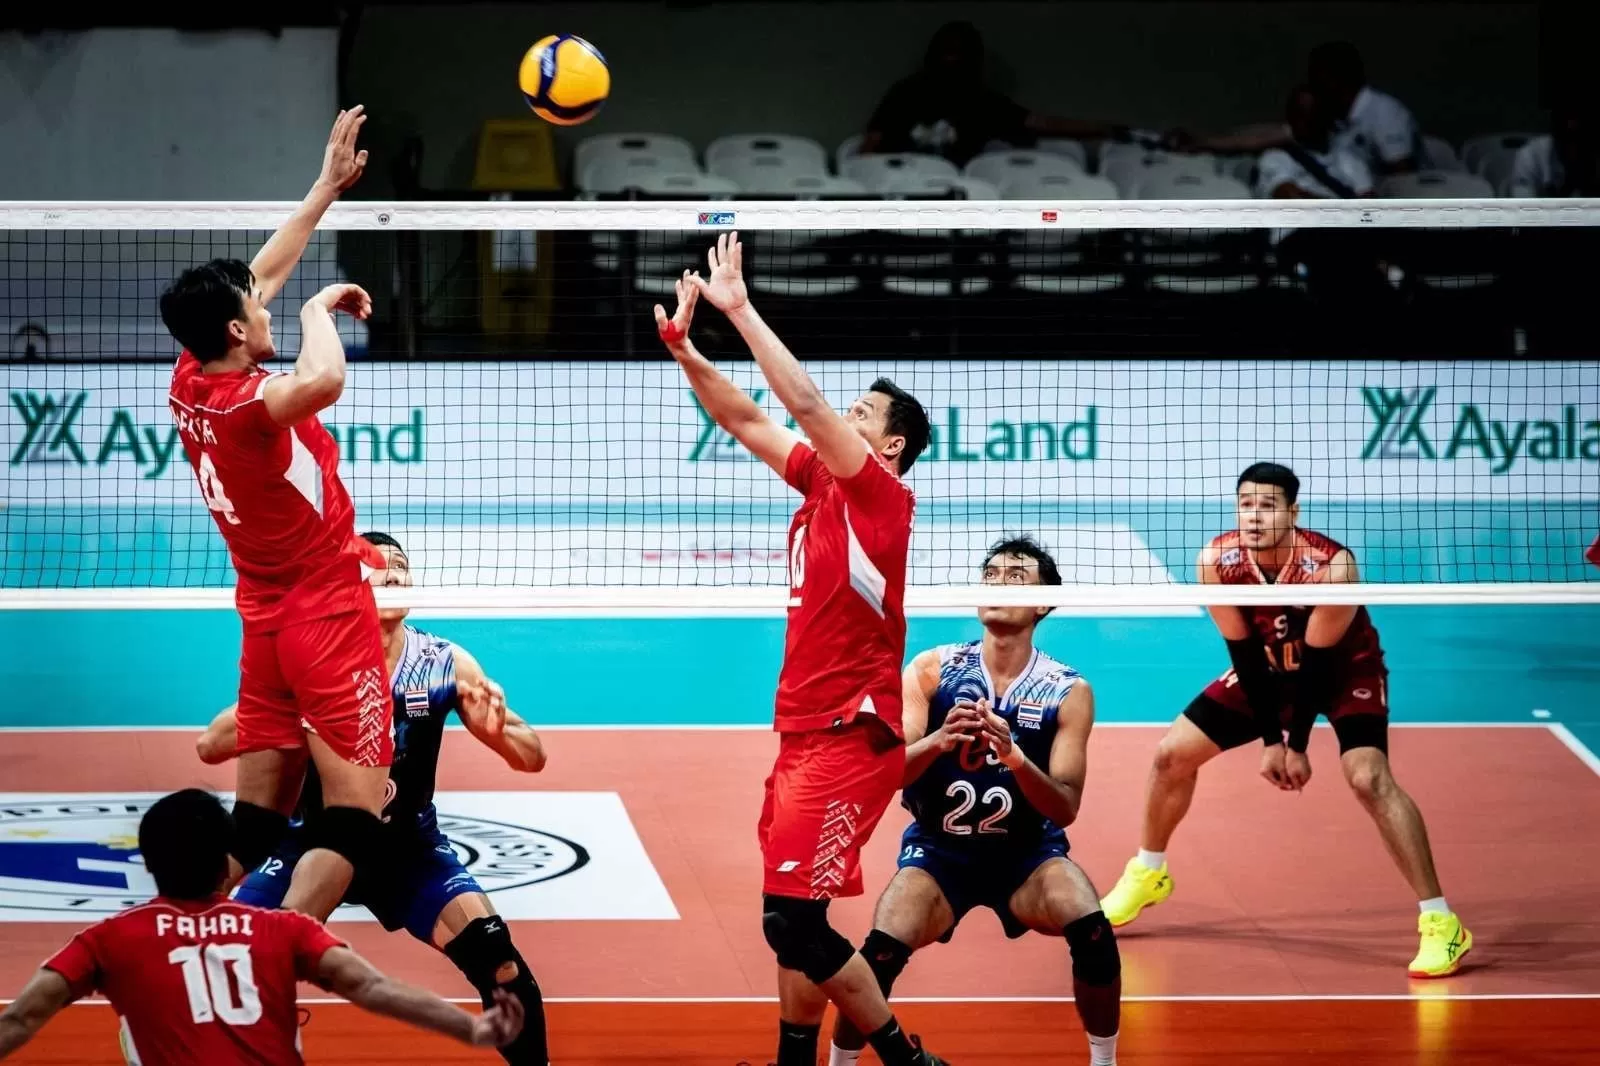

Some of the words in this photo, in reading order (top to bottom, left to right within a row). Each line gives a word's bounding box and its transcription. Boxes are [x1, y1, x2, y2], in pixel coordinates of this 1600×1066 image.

[199, 451, 241, 525] 4
[942, 780, 1013, 835] 22
[259, 857, 284, 876] 12
[168, 942, 263, 1026] 10
